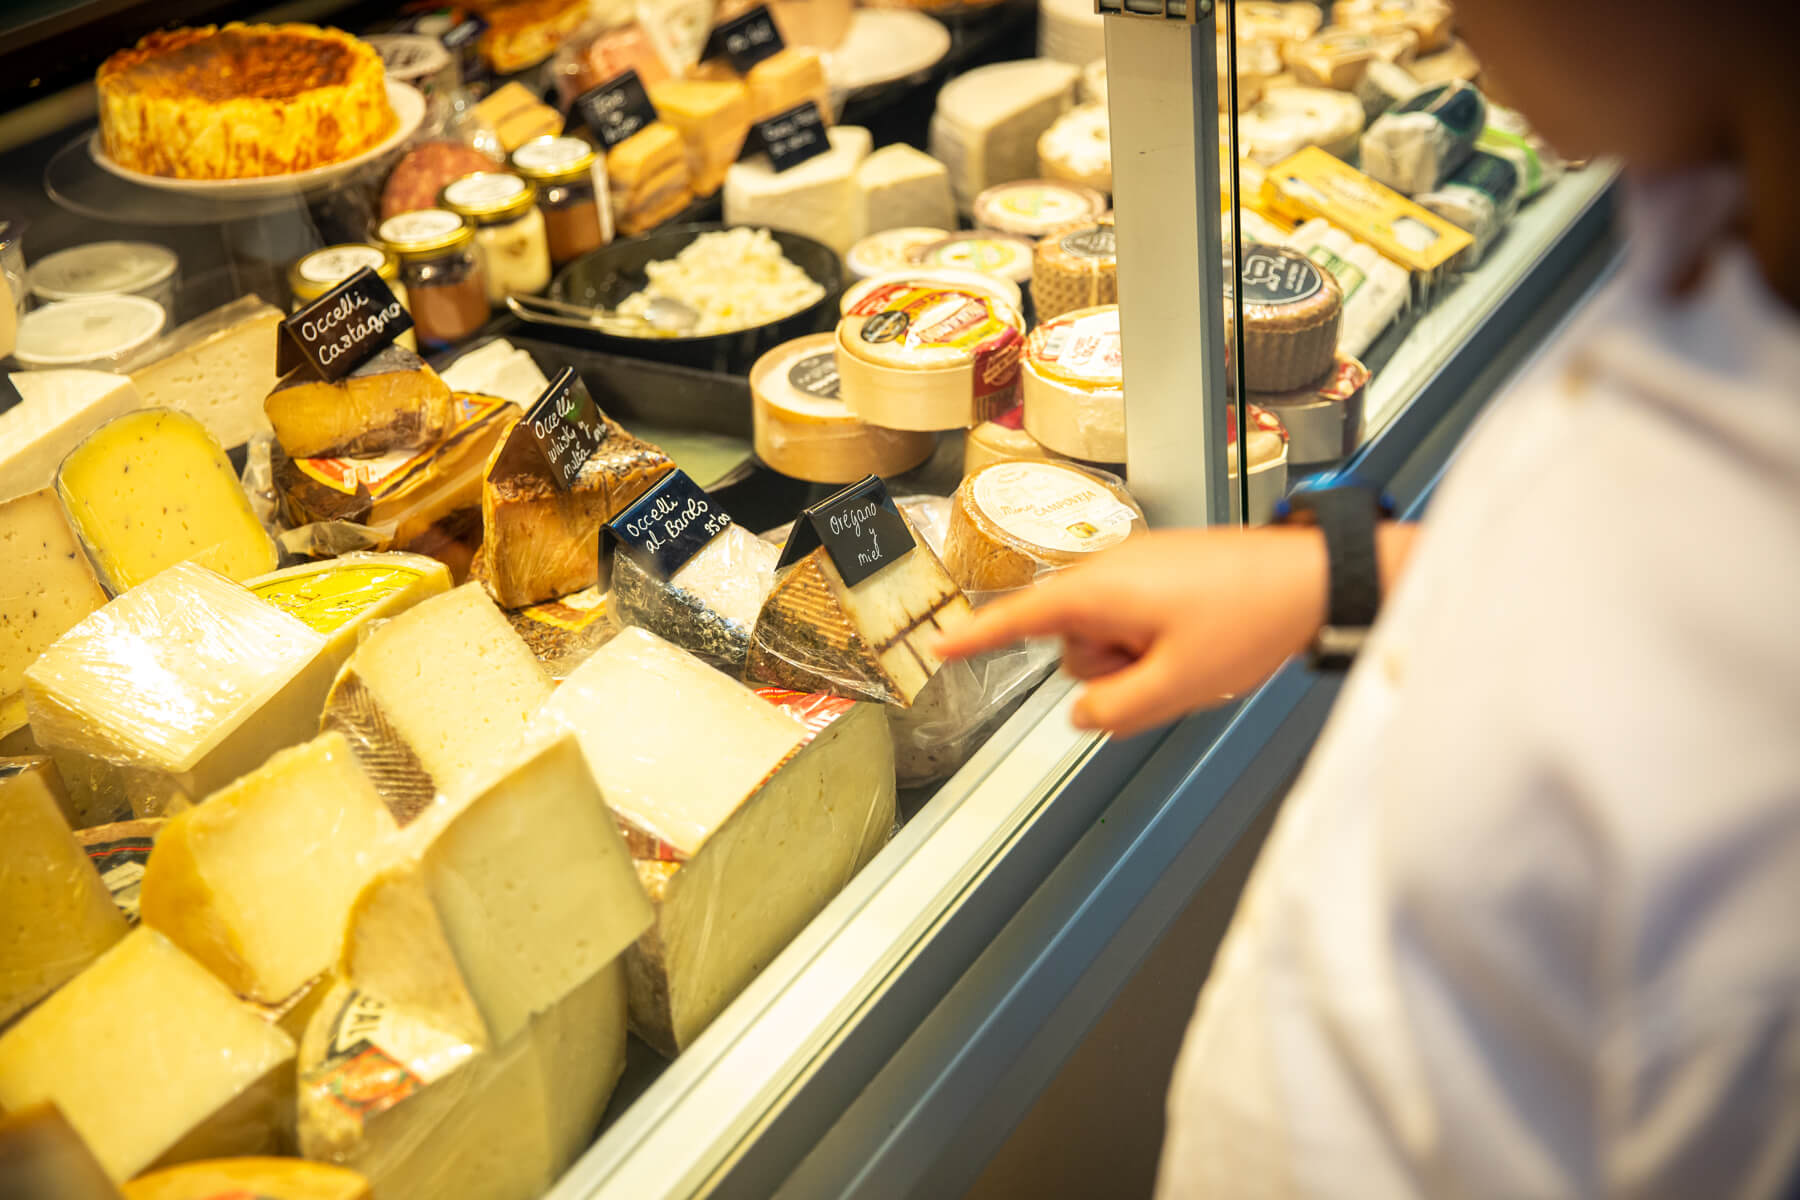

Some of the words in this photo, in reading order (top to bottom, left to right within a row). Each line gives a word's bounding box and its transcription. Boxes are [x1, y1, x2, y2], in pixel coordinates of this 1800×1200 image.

[302, 291, 369, 342] Occelli
[664, 498, 709, 538] Barolo
[829, 502, 877, 537] Orégano
[857, 544, 883, 567] miel
